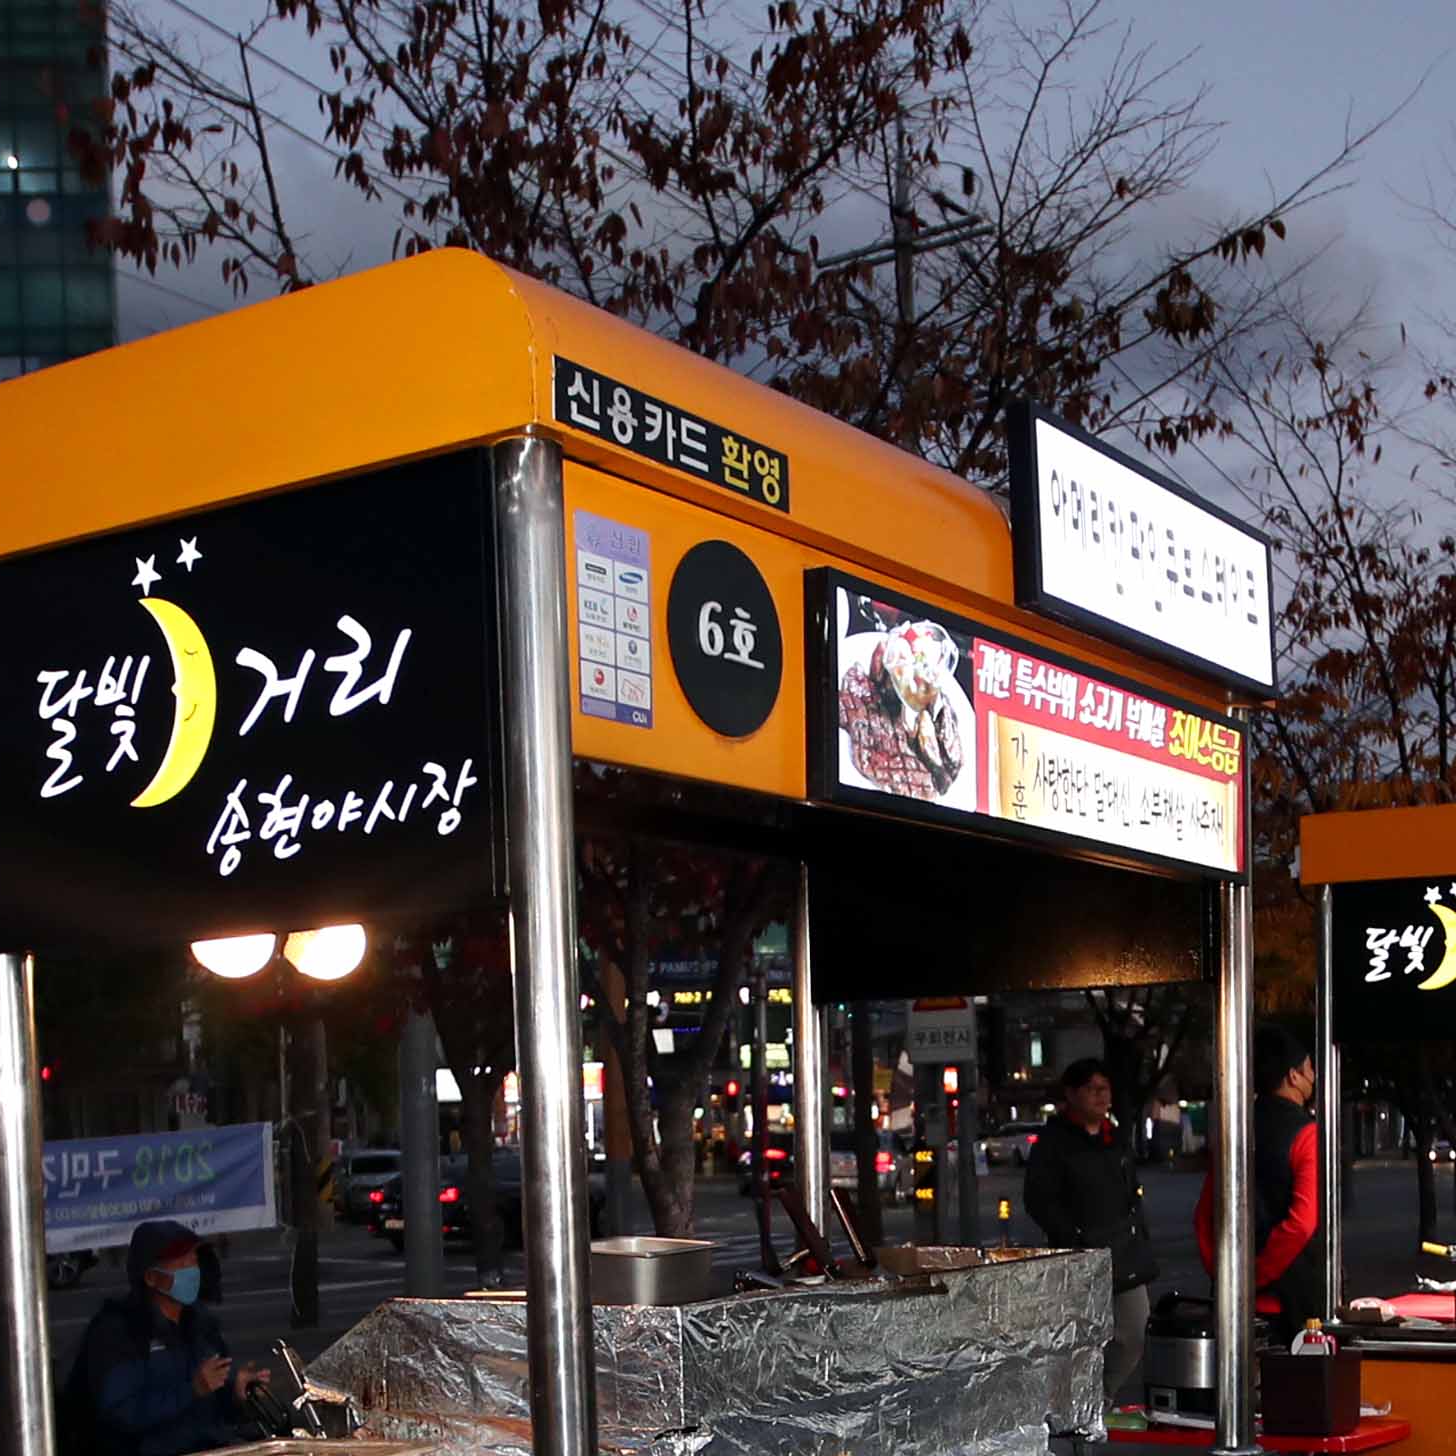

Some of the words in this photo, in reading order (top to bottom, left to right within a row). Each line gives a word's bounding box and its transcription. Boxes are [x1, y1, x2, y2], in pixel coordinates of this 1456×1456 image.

[566, 369, 709, 475] 신용카드
[721, 432, 783, 504] 환영
[698, 601, 766, 670] 6호
[36, 655, 150, 800] 달빛
[236, 615, 412, 737] 거리
[977, 644, 1013, 699] 귀한
[1015, 656, 1079, 721] 특수부위
[1079, 681, 1124, 732] 소고기
[207, 759, 477, 877] 송현야시장
[1364, 926, 1433, 983] 달빛
